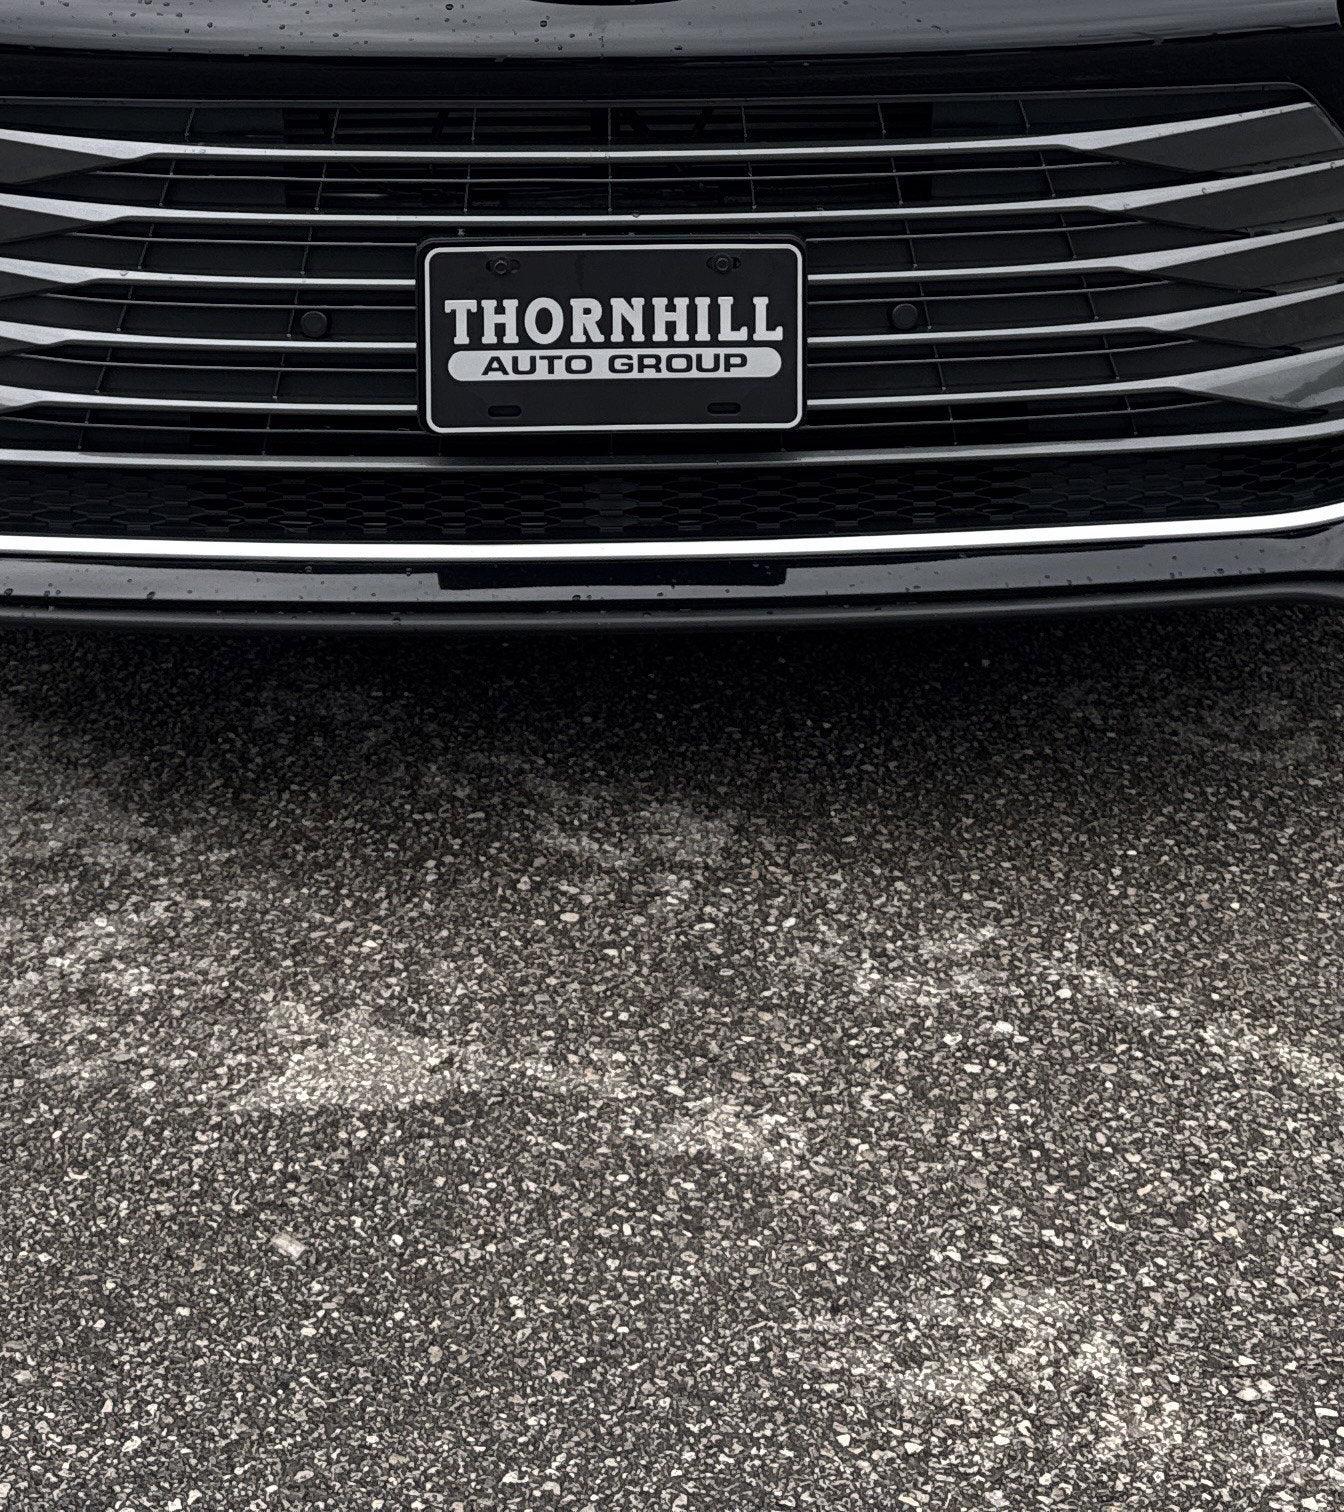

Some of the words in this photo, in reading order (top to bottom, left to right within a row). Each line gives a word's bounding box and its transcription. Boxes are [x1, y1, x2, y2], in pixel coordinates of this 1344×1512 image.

[444, 296, 783, 344] THORNHILL
[481, 355, 593, 376] AUTO
[607, 353, 749, 374] GROUP
